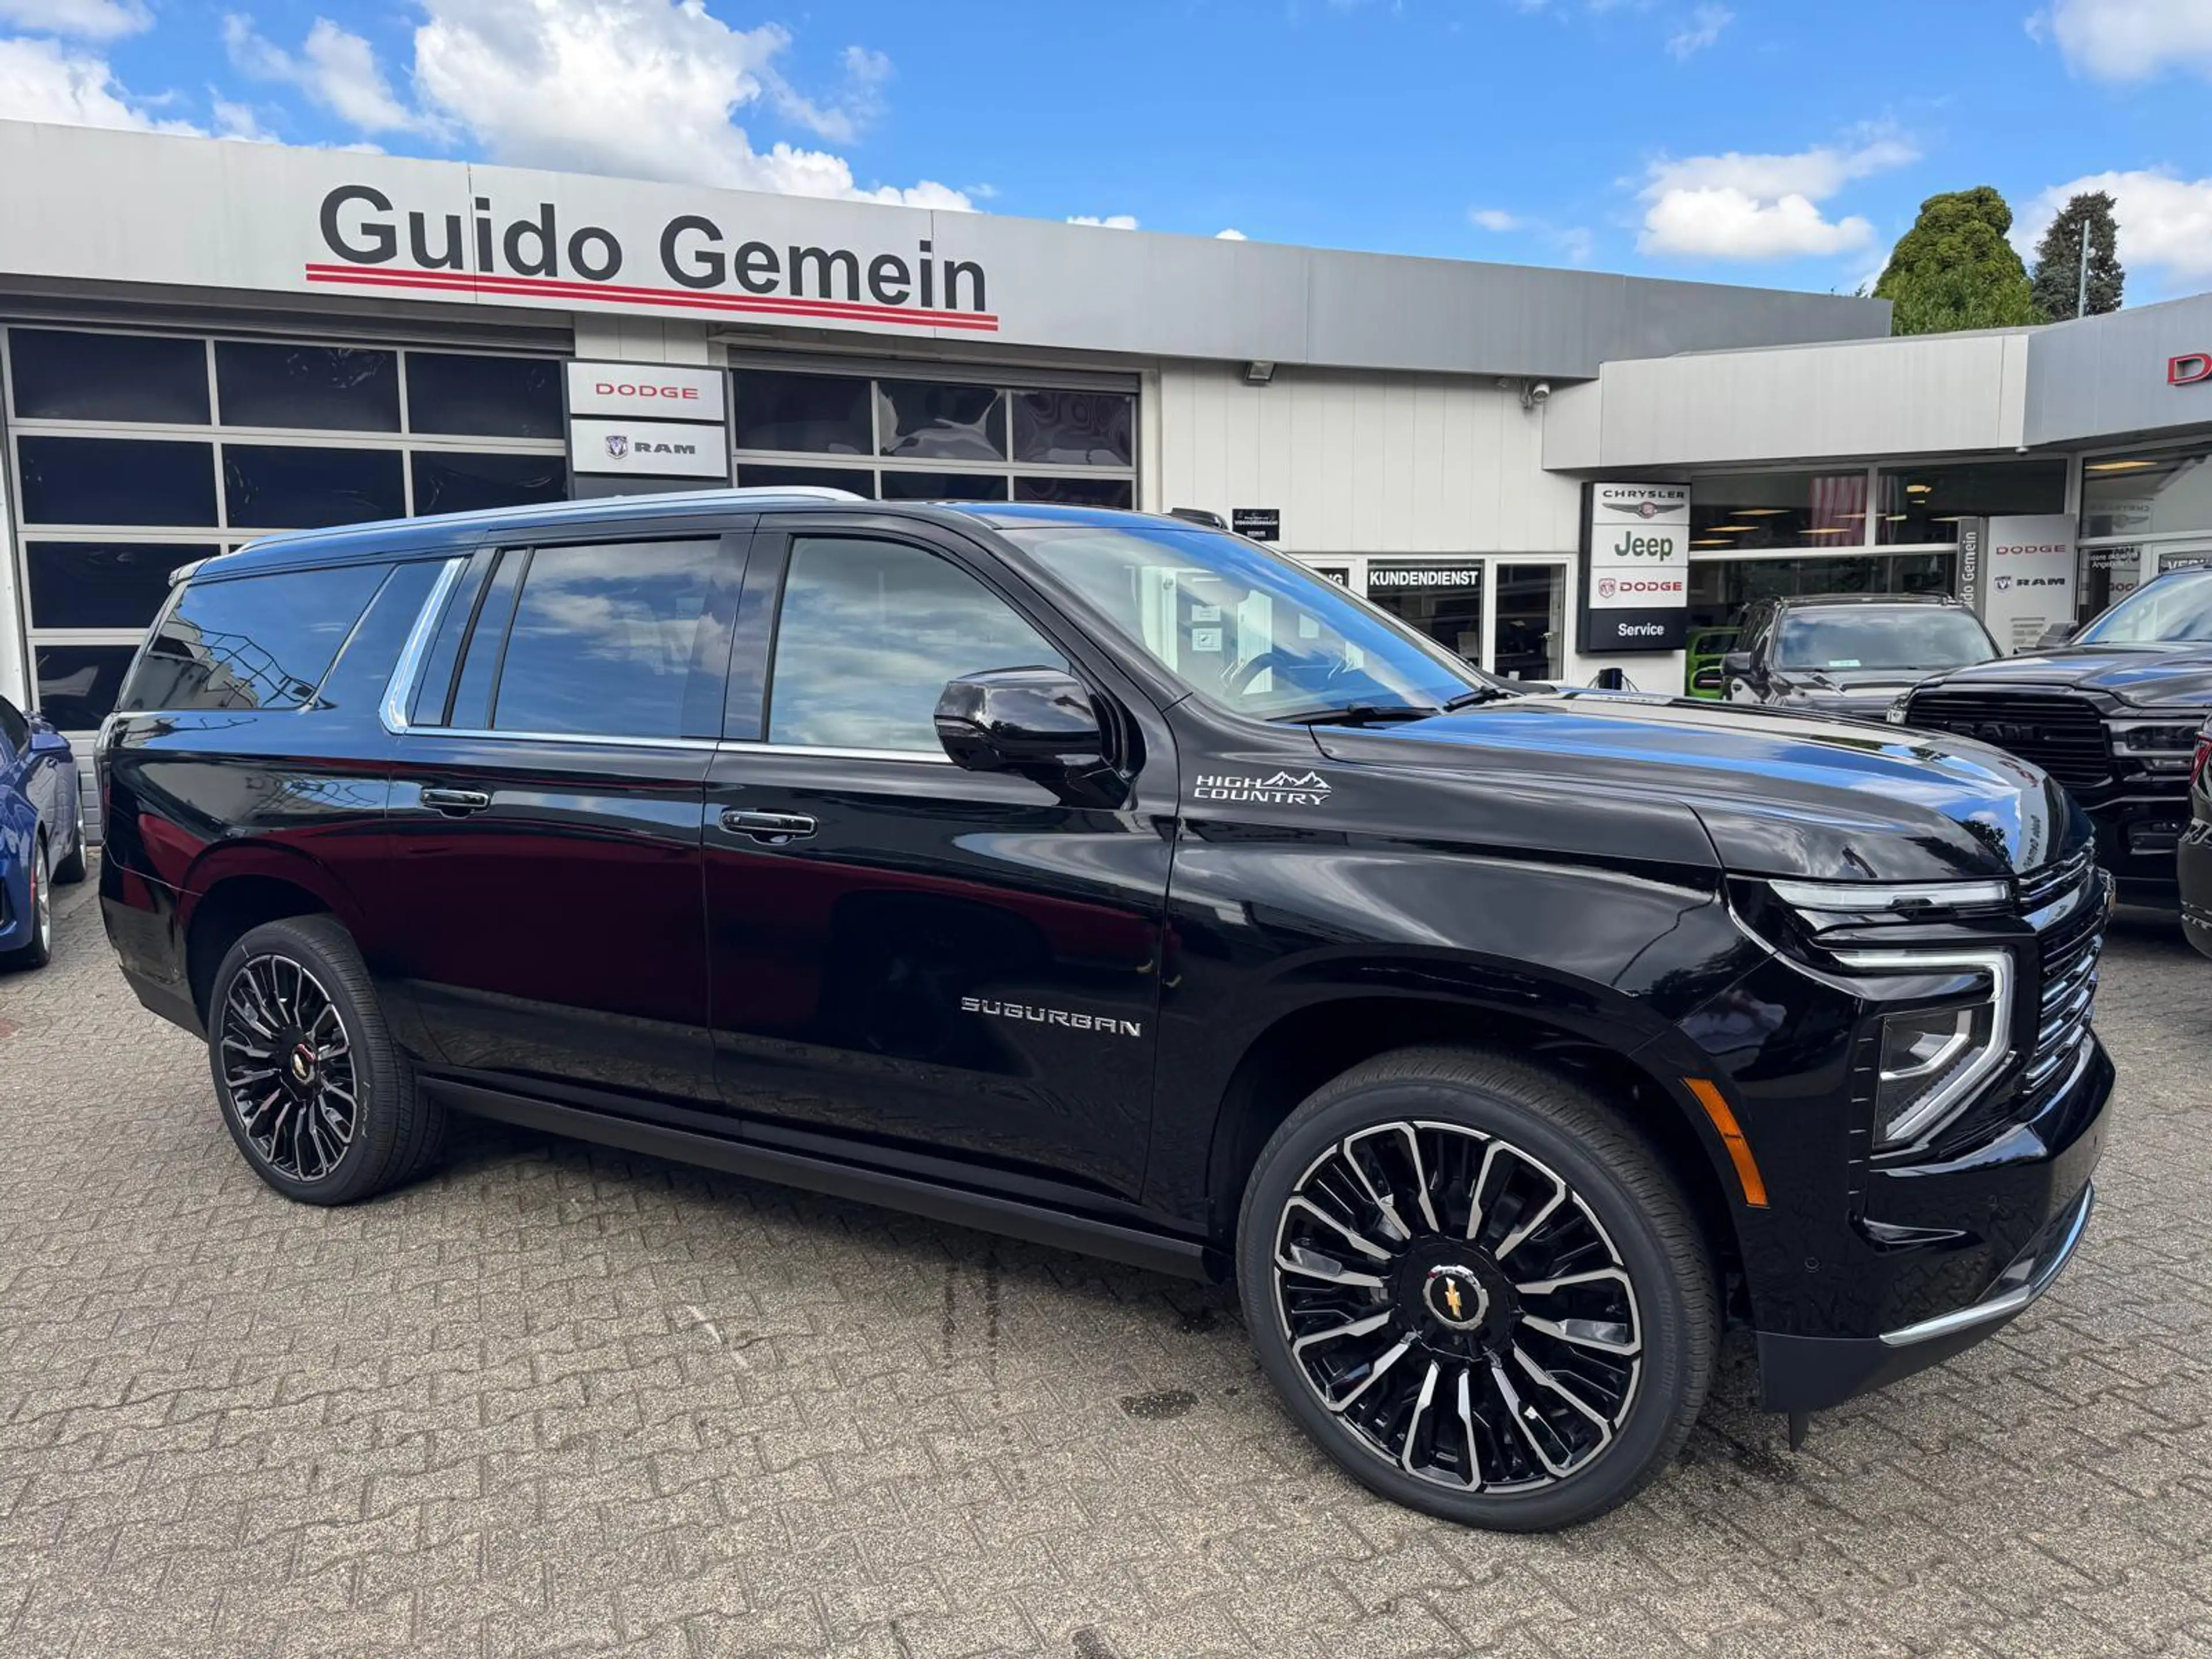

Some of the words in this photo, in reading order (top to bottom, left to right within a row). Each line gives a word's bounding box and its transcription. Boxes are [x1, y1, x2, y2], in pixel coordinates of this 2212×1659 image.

[319, 184, 623, 281] Guido
[659, 214, 986, 312] Gemein
[595, 383, 699, 399] DODGE
[634, 442, 696, 454] RAM
[1603, 490, 1685, 499] CHRYSLER
[1614, 531, 1673, 562] Jeep
[1996, 544, 2066, 555] DODGE
[1962, 531, 1976, 582] Gemein
[1369, 571, 1479, 586] KUNDENDIENST
[2016, 577, 2066, 586] RAM
[1619, 581, 1683, 592] DODGE
[1618, 622, 1665, 637] Service
[1196, 775, 1263, 789] HIGH
[1194, 787, 1330, 806] COUNTRY
[961, 996, 1141, 1037] SUBURBAN
